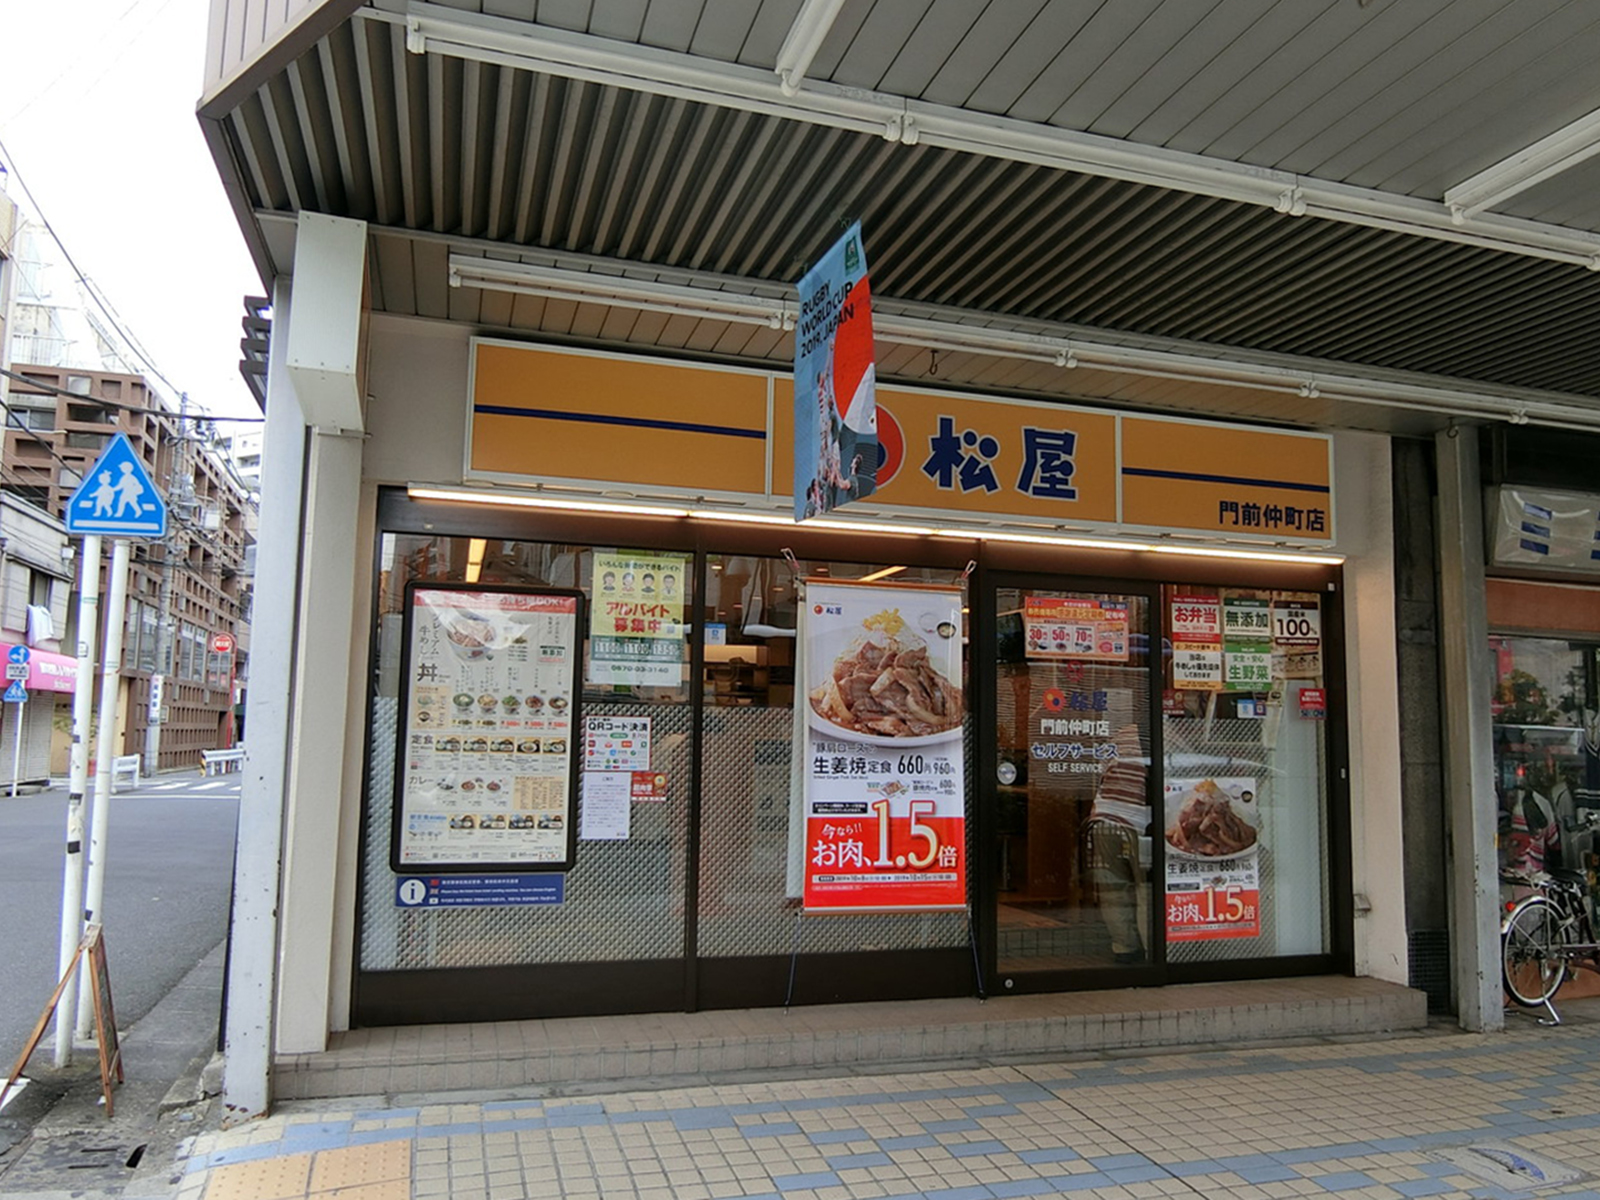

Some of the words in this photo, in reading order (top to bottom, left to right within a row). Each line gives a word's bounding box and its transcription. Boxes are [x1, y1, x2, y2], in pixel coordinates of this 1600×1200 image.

[801, 279, 831, 318] RUGBY
[801, 300, 832, 337] WORLD
[832, 281, 853, 310] CUP
[823, 303, 854, 341] JAPAN
[922, 414, 1078, 501] 松屋
[1218, 500, 1326, 533] 門前仲町店
[606, 602, 670, 618] アルバイト
[825, 606, 842, 616] 松屋
[1174, 605, 1217, 624] お弁当
[614, 617, 662, 634] 募集中
[1226, 610, 1269, 629] 無添加
[1276, 617, 1318, 637] 100%
[1232, 654, 1265, 663] 安全・安心
[417, 662, 438, 682] 丼
[1229, 664, 1269, 680] 生野菜
[1069, 690, 1108, 711] 松屋
[587, 721, 648, 732] QRコード決済
[1041, 718, 1110, 735] 門前仲町店
[411, 734, 433, 745] 定食
[1032, 742, 1119, 759] セルフサービス
[812, 756, 892, 775] 生姜焼定食
[1048, 763, 1068, 773] SELF
[1070, 763, 1103, 773] SERVICE
[408, 776, 434, 785] カレー
[822, 822, 863, 840] 今なら!!
